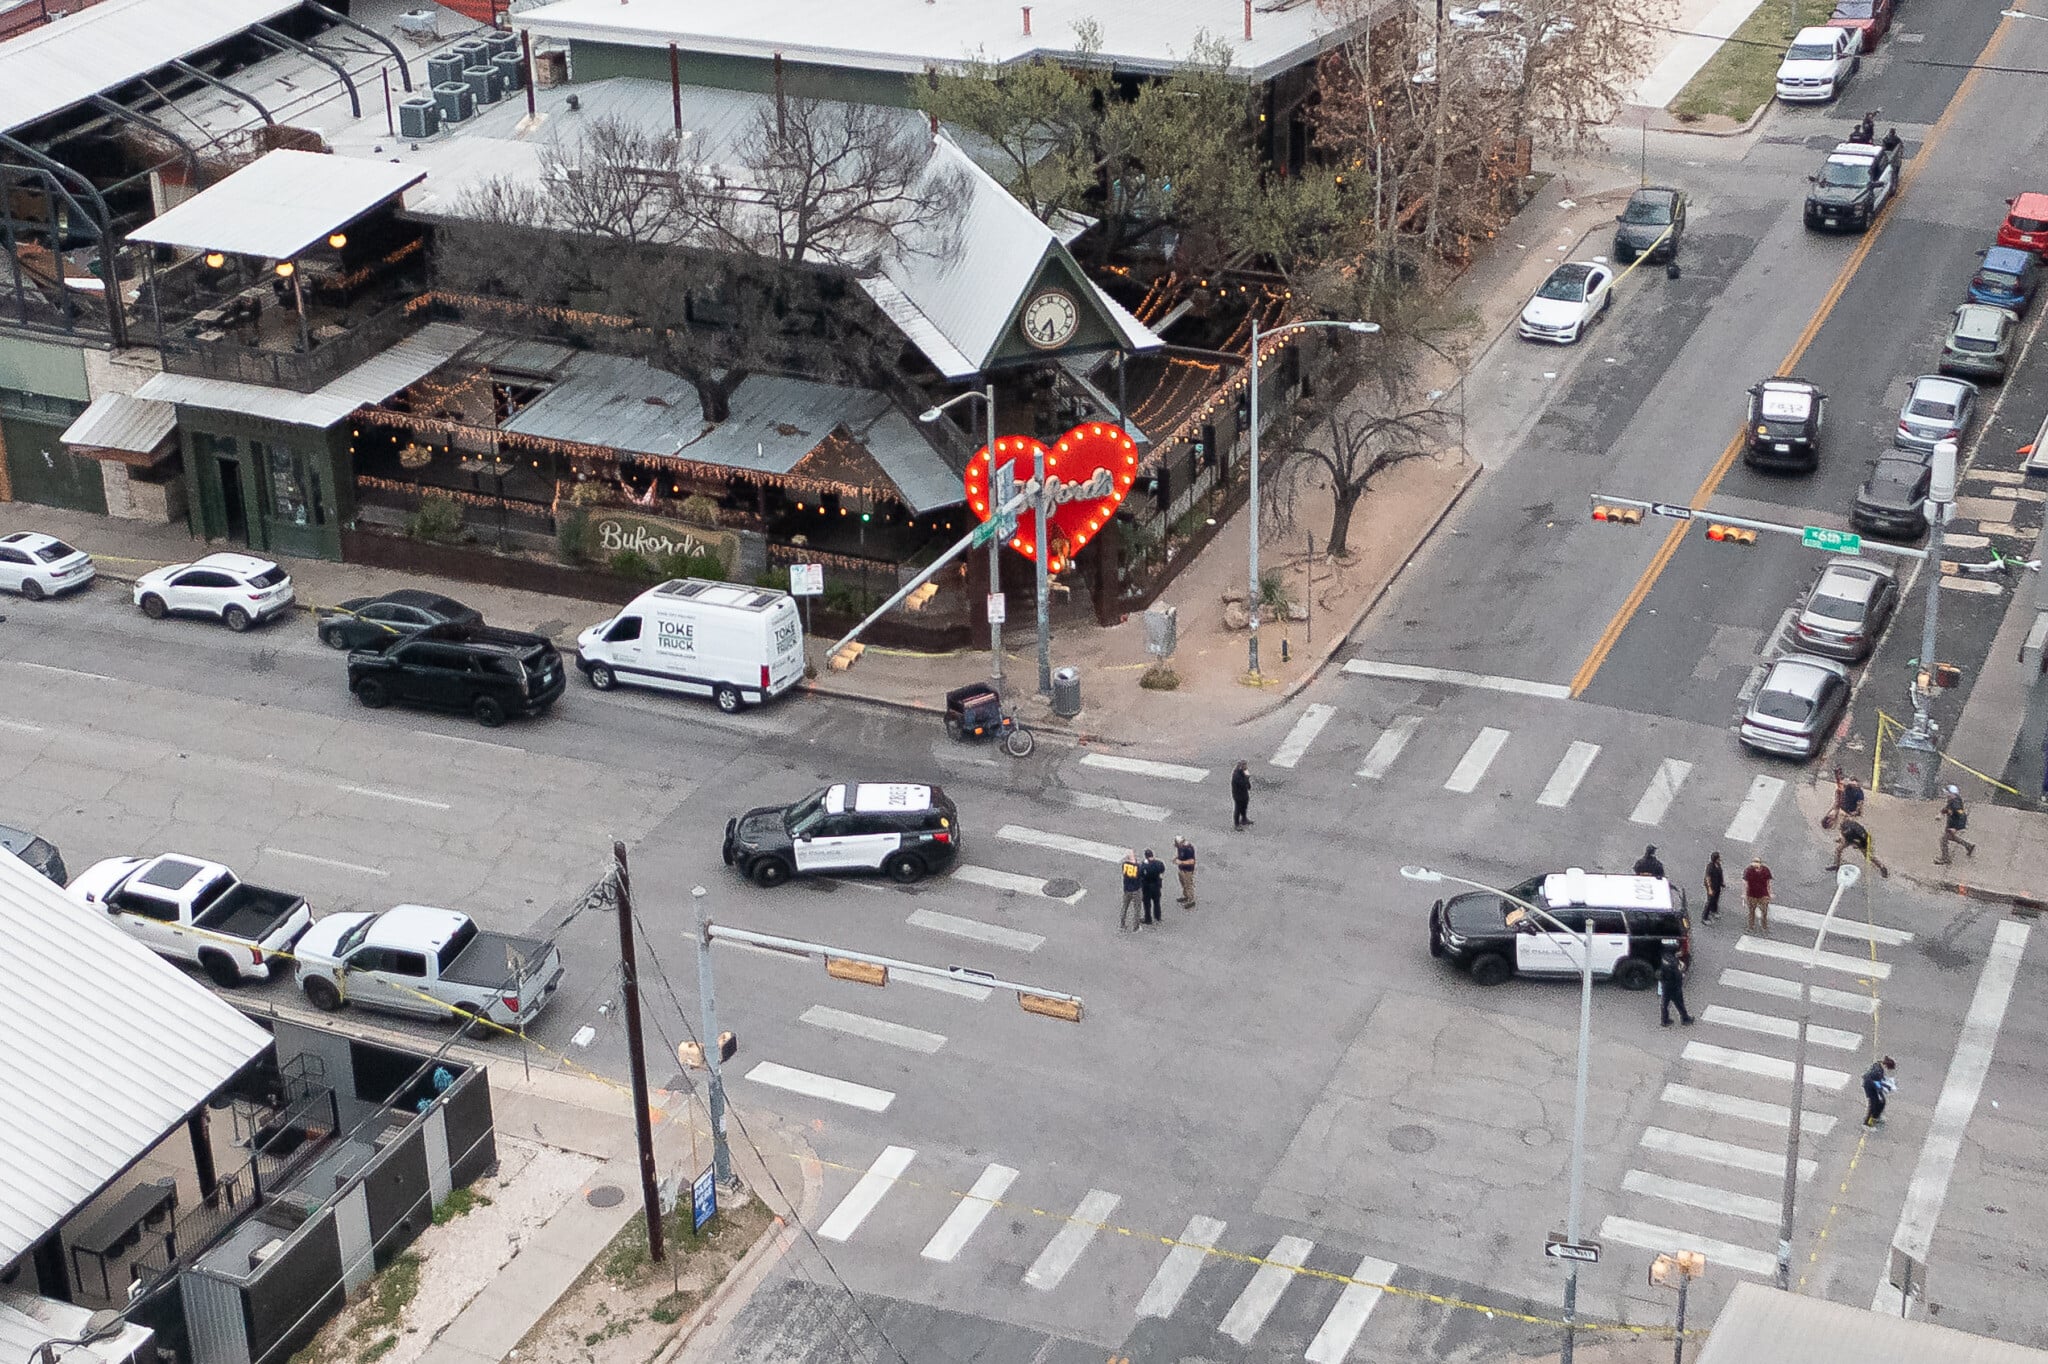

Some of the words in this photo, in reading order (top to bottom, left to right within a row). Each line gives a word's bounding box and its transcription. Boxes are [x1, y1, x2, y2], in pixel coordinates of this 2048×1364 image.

[599, 520, 706, 558] Buford's
[658, 620, 694, 637] TOKE
[775, 621, 796, 642] TOKE
[658, 637, 694, 652] TRUCK
[1123, 863, 1139, 878] FBI
